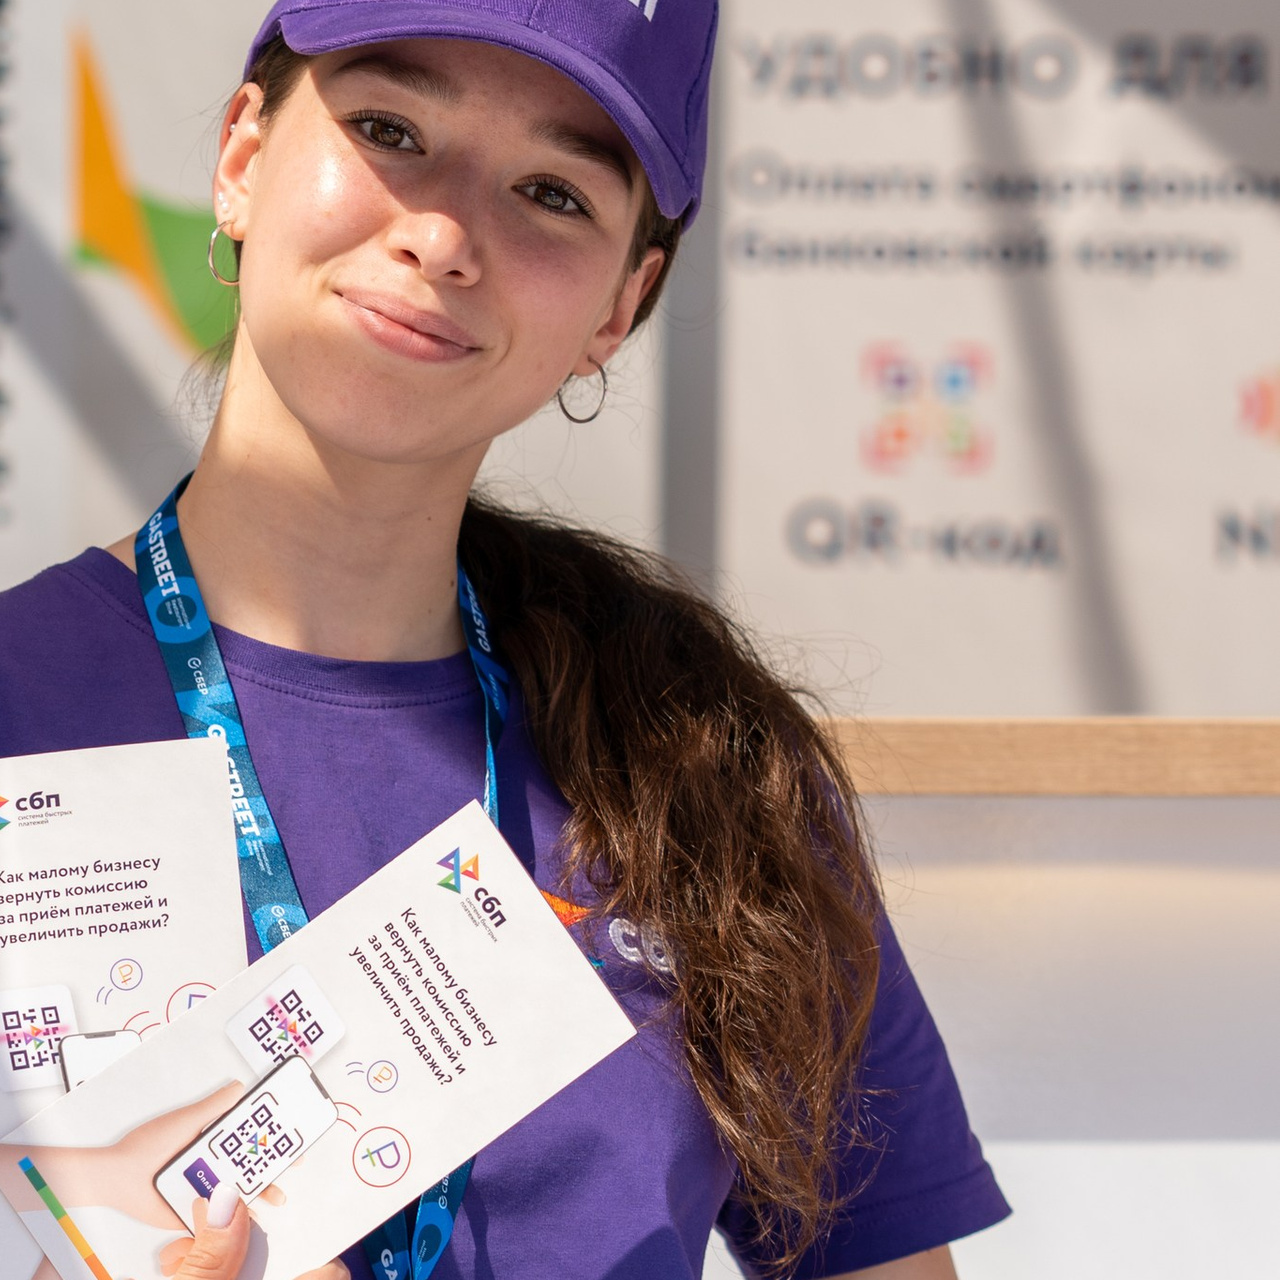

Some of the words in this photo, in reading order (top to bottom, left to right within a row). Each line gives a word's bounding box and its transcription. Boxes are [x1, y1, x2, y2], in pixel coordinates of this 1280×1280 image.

[148, 512, 180, 597] GASTREET
[193, 670, 209, 696] СБЕР
[15, 791, 61, 811] сбп
[29, 865, 89, 881] малому
[93, 858, 161, 873] бизнесу
[65, 879, 148, 897] комиссию
[19, 906, 70, 924] приём
[75, 896, 153, 915] платежей
[158, 898, 168, 907] и
[474, 887, 507, 928] сбп
[0, 928, 83, 948] увеличить
[88, 913, 169, 937] продажи?
[277, 920, 292, 941] СБЕ
[609, 918, 677, 972] сб
[384, 922, 423, 977] вернуть
[422, 977, 472, 1047] комиссию
[401, 907, 422, 939] Как
[420, 937, 458, 989] малому
[456, 989, 497, 1047] бизнесу
[349, 946, 401, 1018] увеличить
[400, 1018, 453, 1085] продажи?
[368, 935, 382, 952] за
[380, 951, 413, 997] приём
[410, 997, 461, 1063] платежей
[455, 1063, 466, 1075] и
[197, 1171, 214, 1192] Оплат
